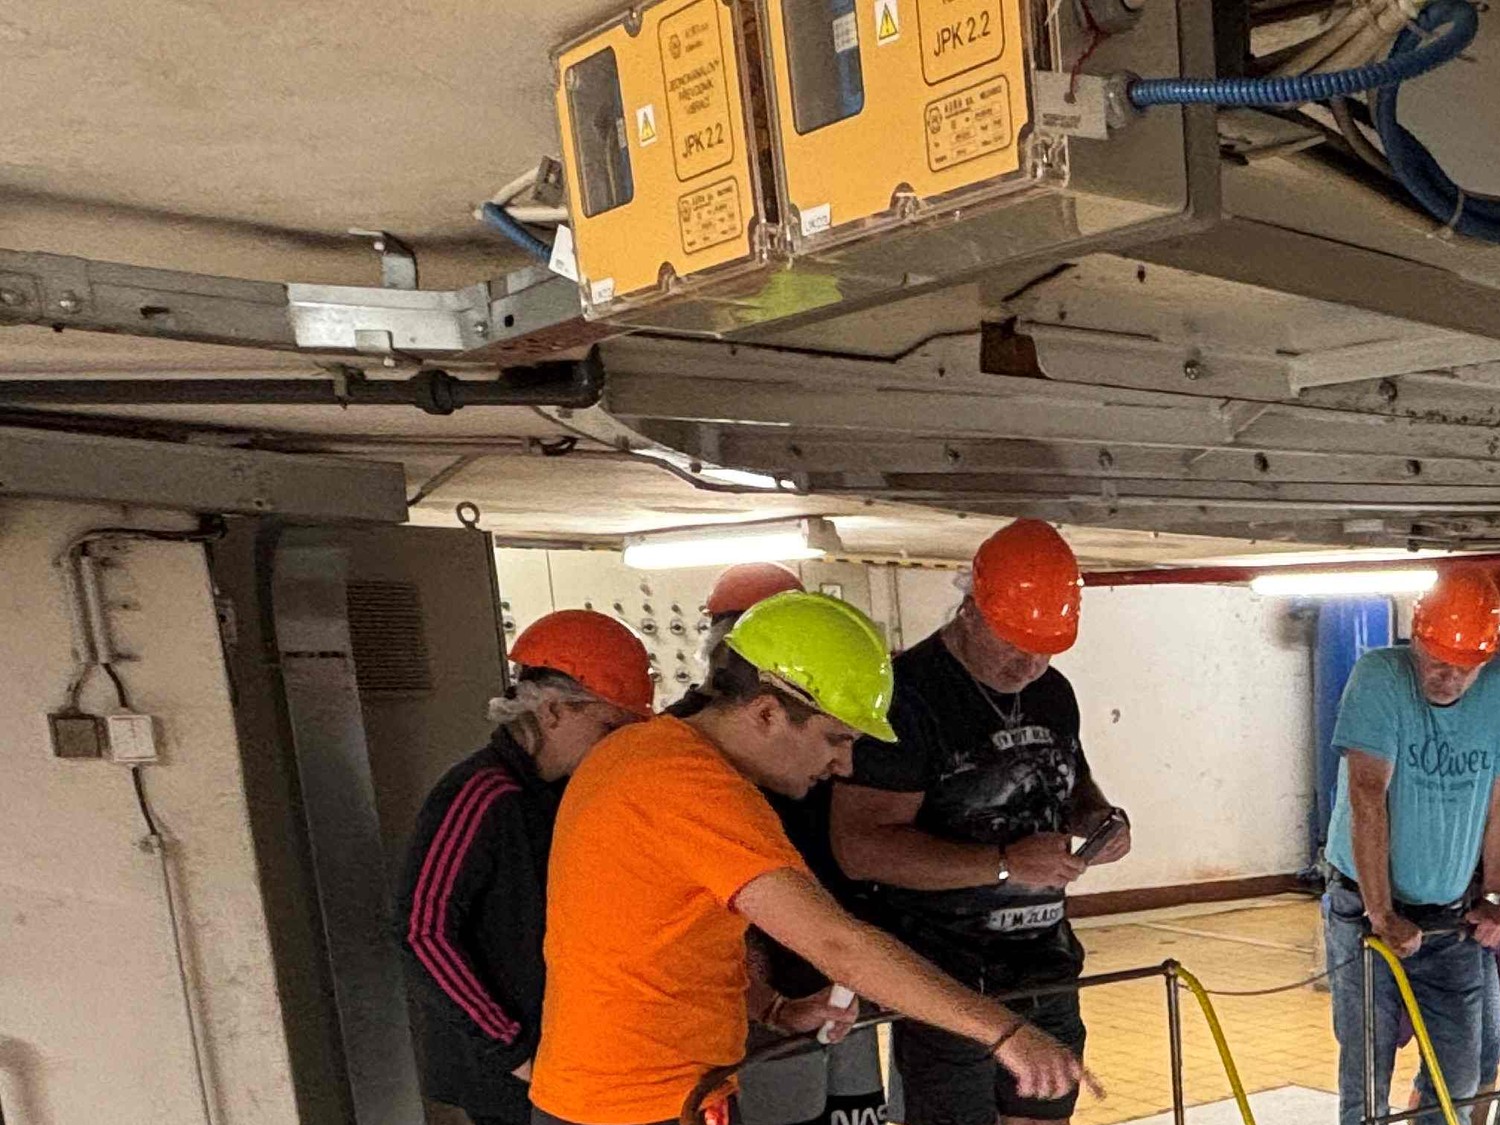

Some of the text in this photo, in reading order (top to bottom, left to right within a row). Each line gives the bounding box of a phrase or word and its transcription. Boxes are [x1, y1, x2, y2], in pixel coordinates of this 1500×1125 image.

[933, 10, 991, 57] JPK 2.2
[682, 131, 704, 158] JPK
[1407, 737, 1491, 778] s.Oliver
